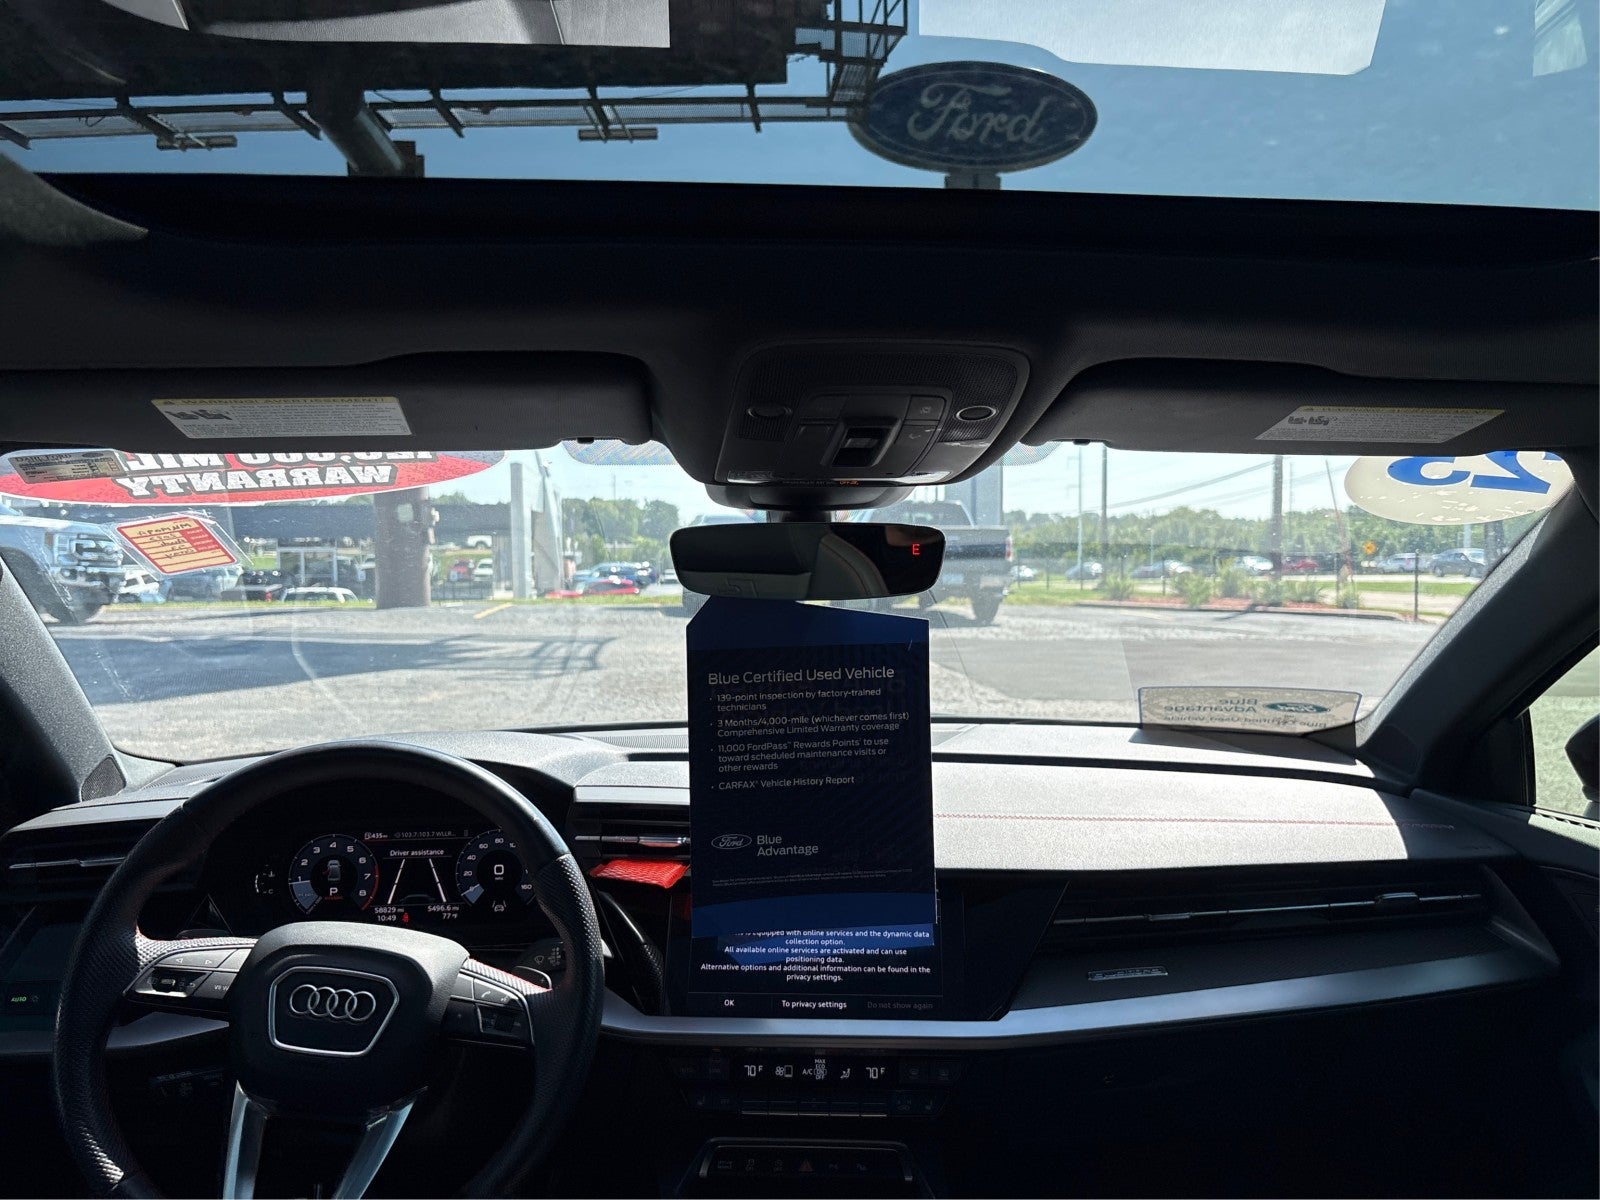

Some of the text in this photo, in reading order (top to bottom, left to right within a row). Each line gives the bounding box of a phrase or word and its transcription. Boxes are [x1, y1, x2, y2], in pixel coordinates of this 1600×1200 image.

[906, 82, 1059, 145] Ford
[912, 543, 921, 556] E
[708, 665, 896, 685] Blue Certified Used Vehicle
[760, 691, 804, 701] inspection
[805, 690, 816, 699] by
[817, 688, 882, 699] factory-trained
[717, 702, 767, 712] technicians
[717, 711, 909, 728] 3 Months/4,000-mile (whichever comes first)
[717, 722, 900, 738] Comprehensive Limited Warranty coverage
[718, 743, 745, 754] 11,000
[794, 739, 831, 750] Rewards
[863, 738, 872, 747] to
[873, 738, 889, 746] use
[718, 747, 887, 762] toward scheduled maintenance visits or
[718, 761, 779, 773] other rewards
[760, 778, 792, 788] Vehicle
[793, 777, 824, 786] History
[825, 775, 855, 784] Report
[719, 835, 745, 848] Ford
[757, 834, 783, 845] Blue
[390, 849, 410, 857] Driver
[757, 845, 819, 857] Advantage
[301, 858, 308, 866] 2
[359, 856, 366, 864] 6
[494, 864, 504, 875] 0
[363, 872, 371, 880] 7
[330, 887, 338, 896] P
[359, 889, 367, 897] 8
[883, 930, 912, 939] dynamic
[785, 938, 845, 946] collection option.
[832, 947, 865, 955] activated
[785, 956, 845, 964] positioning data.
[700, 963, 740, 971] Alternative
[740, 964, 767, 972] options
[783, 964, 819, 972] additional
[878, 965, 887, 973] be
[887, 965, 909, 973] found
[918, 966, 931, 974] the
[786, 974, 844, 983] privacy settings.
[724, 999, 735, 1007] OK
[781, 1000, 848, 1010] To privacy settings
[866, 1001, 878, 1009] Do
[912, 1002, 933, 1011] again
[744, 1065, 756, 1077] 70
[866, 1067, 878, 1079] 70
